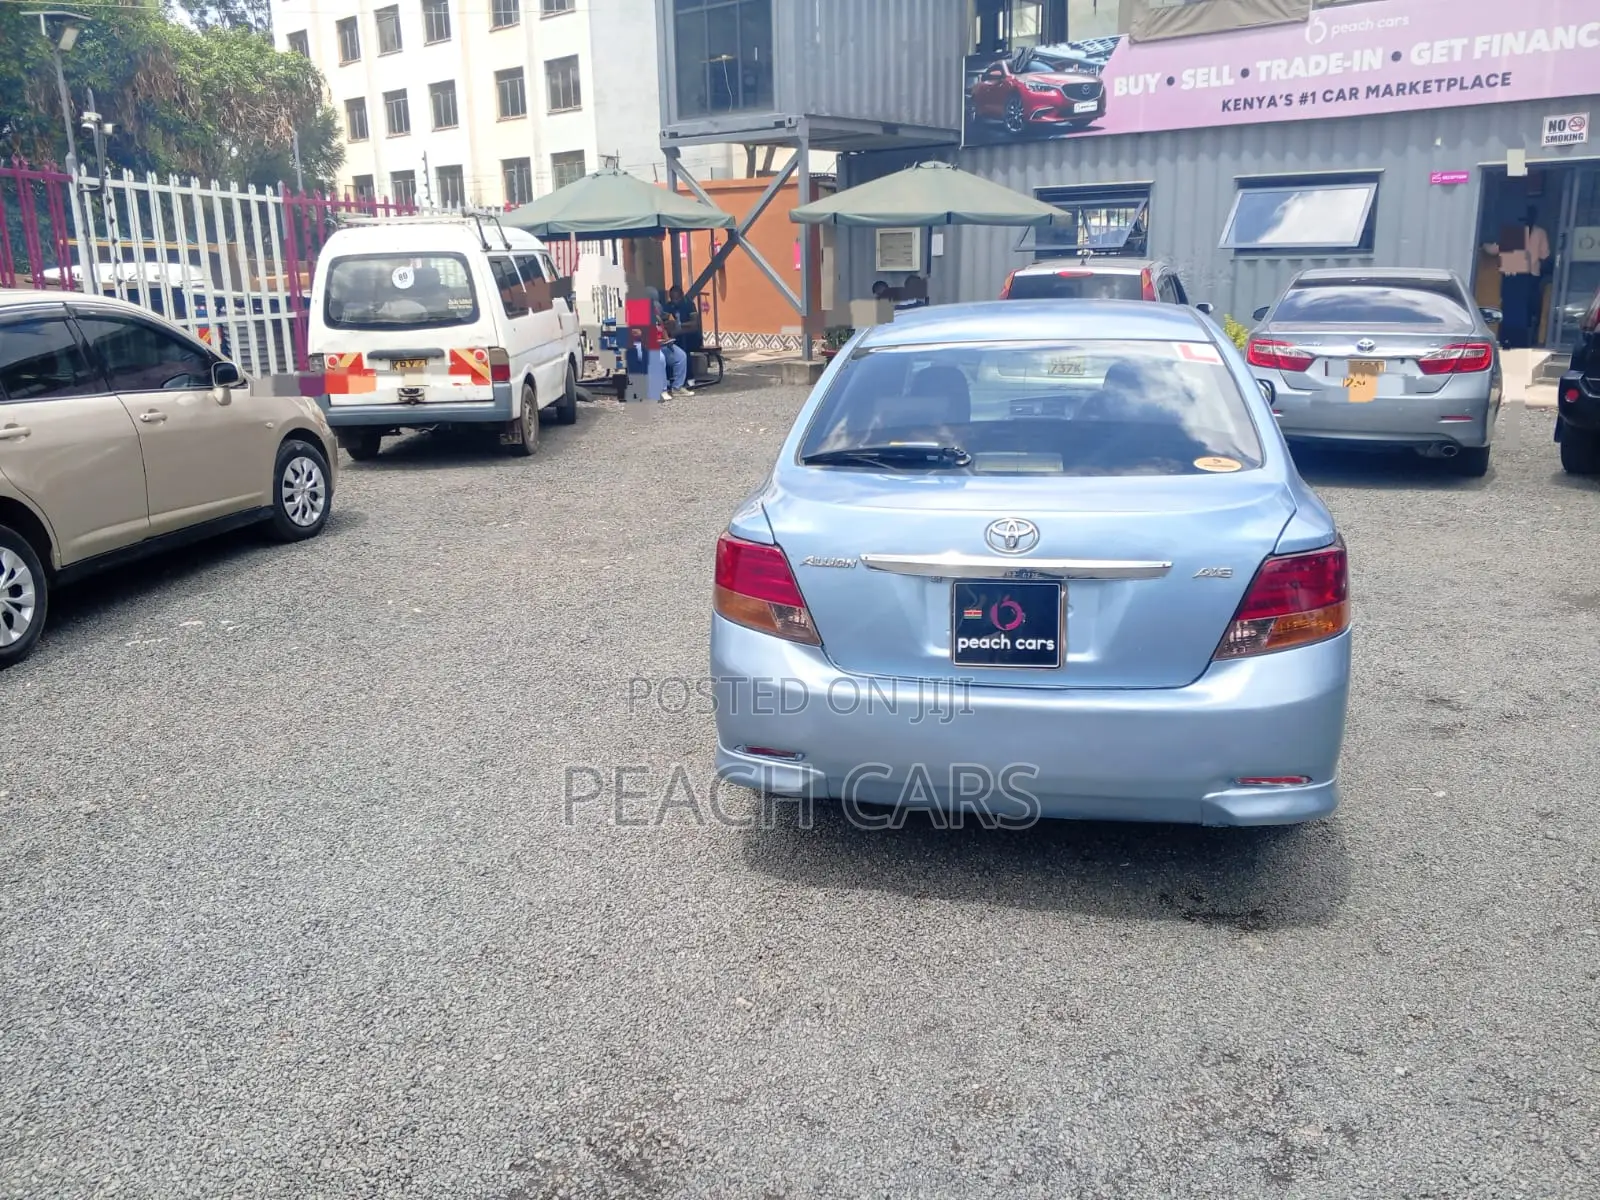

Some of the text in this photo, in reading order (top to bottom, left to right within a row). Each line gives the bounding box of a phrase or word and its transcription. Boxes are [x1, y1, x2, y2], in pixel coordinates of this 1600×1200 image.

[1331, 16, 1410, 38] peach cars
[1114, 22, 1600, 97] BUY SELL TRADE-IN GET FINANC
[1221, 72, 1512, 112] KENYA'S #1 CAR MARKETPLACE
[1548, 119, 1566, 132] NO
[1545, 133, 1584, 144] SMOKING
[958, 633, 1055, 653] peach cars
